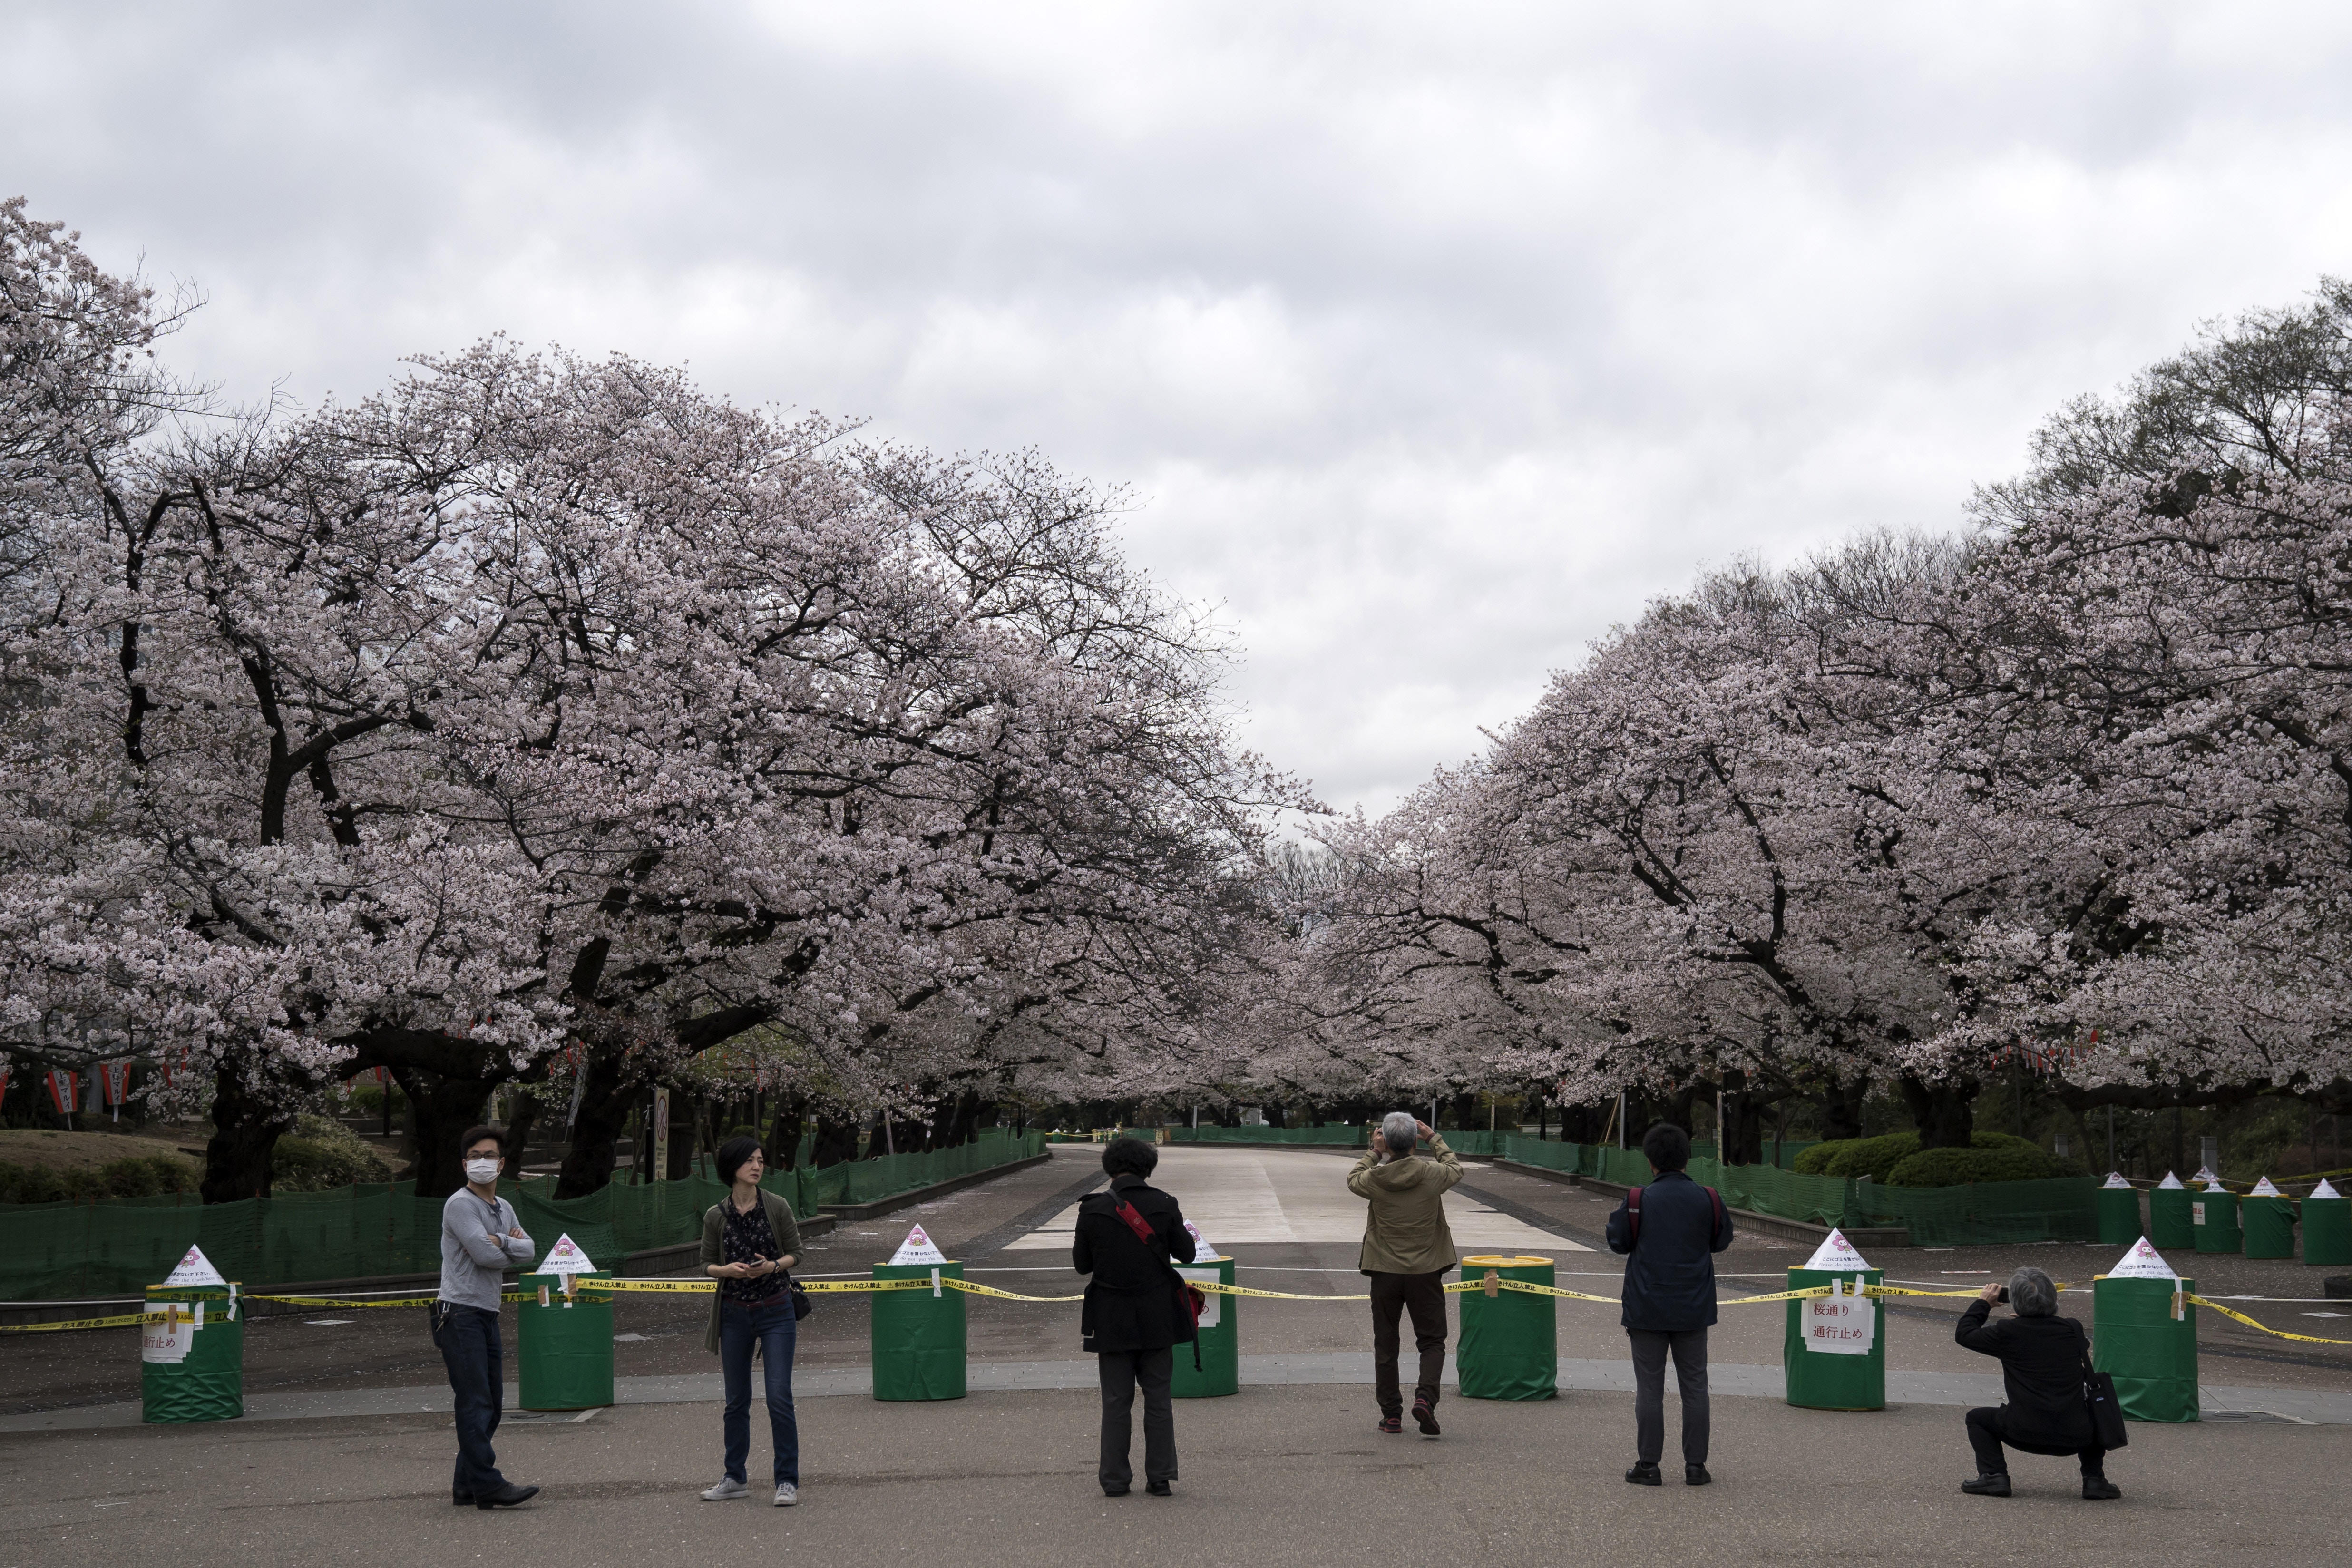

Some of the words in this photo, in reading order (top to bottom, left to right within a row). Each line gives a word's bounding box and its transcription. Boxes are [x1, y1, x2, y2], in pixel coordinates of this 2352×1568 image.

[945, 1279, 981, 1292] きけん立入禁止
[1760, 1291, 1799, 1300] きけん立入禁止
[1814, 1303, 1849, 1316] 桜通り
[60, 1320, 92, 1329] 立入禁止
[135, 1312, 166, 1323] 立入禁止
[1813, 1325, 1863, 1339] 通行止め
